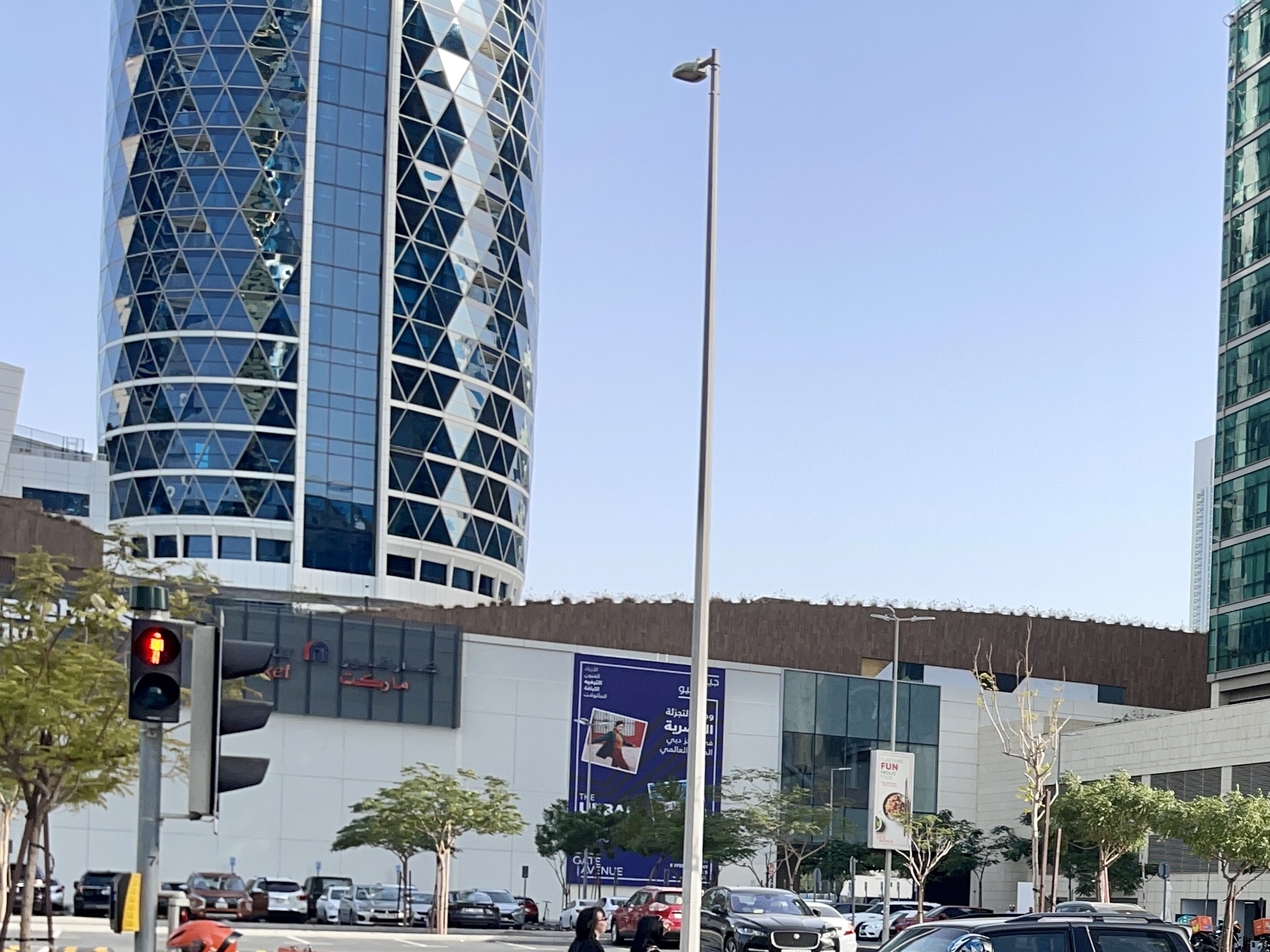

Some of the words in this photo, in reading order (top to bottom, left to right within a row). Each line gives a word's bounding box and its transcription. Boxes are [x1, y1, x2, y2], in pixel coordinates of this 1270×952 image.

[880, 762, 898, 771] FUN
[579, 793, 595, 802] THE
[572, 855, 601, 867] GATE
[580, 866, 623, 876] AVENUE
